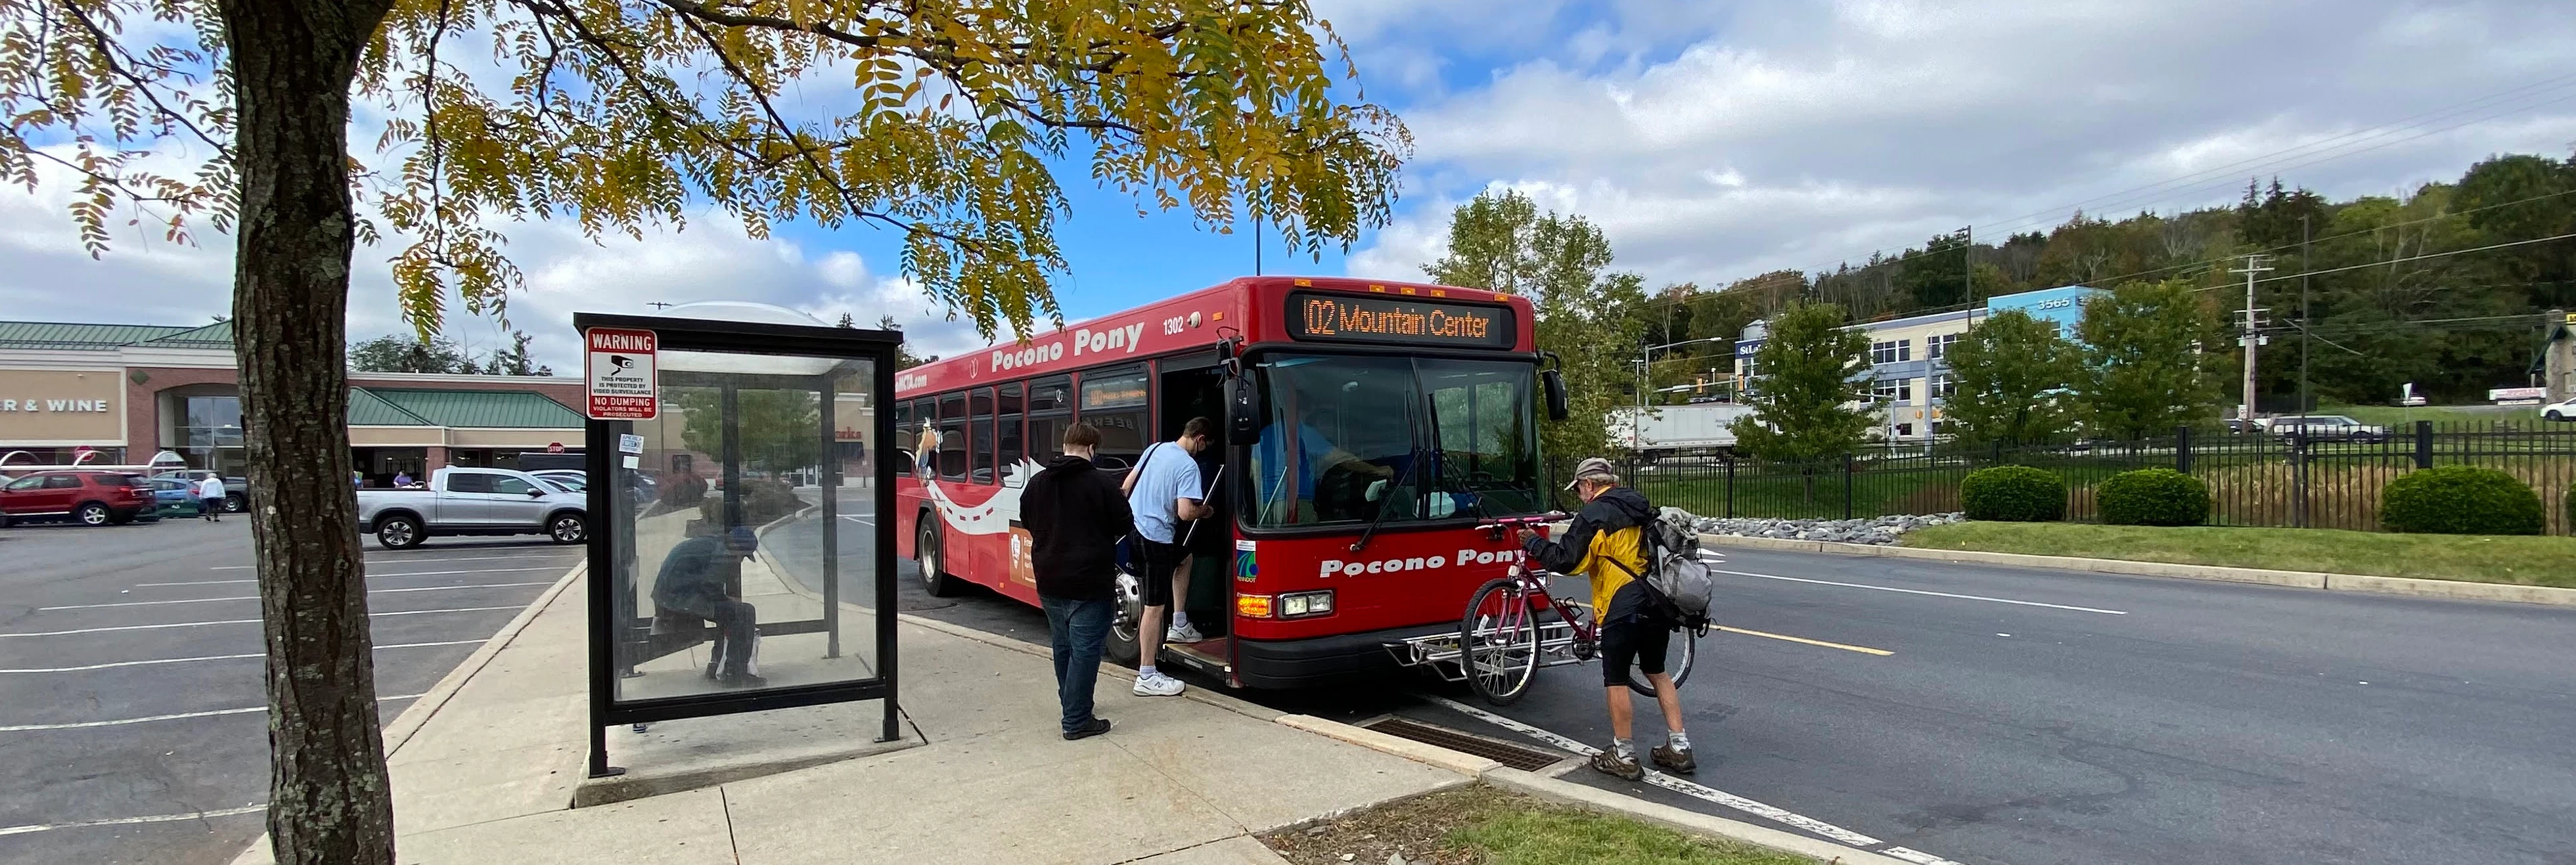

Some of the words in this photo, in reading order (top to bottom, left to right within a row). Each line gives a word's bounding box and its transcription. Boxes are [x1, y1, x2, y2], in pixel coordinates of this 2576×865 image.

[2038, 298, 2070, 310] 3565
[1164, 316, 1184, 336] 1302
[1340, 303, 1426, 336] Mountain
[1430, 309, 1489, 338] Center
[593, 334, 652, 351] WARNING
[991, 342, 1064, 373] Pocono
[1074, 322, 1145, 357] Pony
[24, 399, 39, 412] &
[47, 399, 107, 412] WINE
[595, 397, 607, 405] NO
[610, 397, 650, 407] DUMPING
[1320, 556, 1445, 578] Pocono
